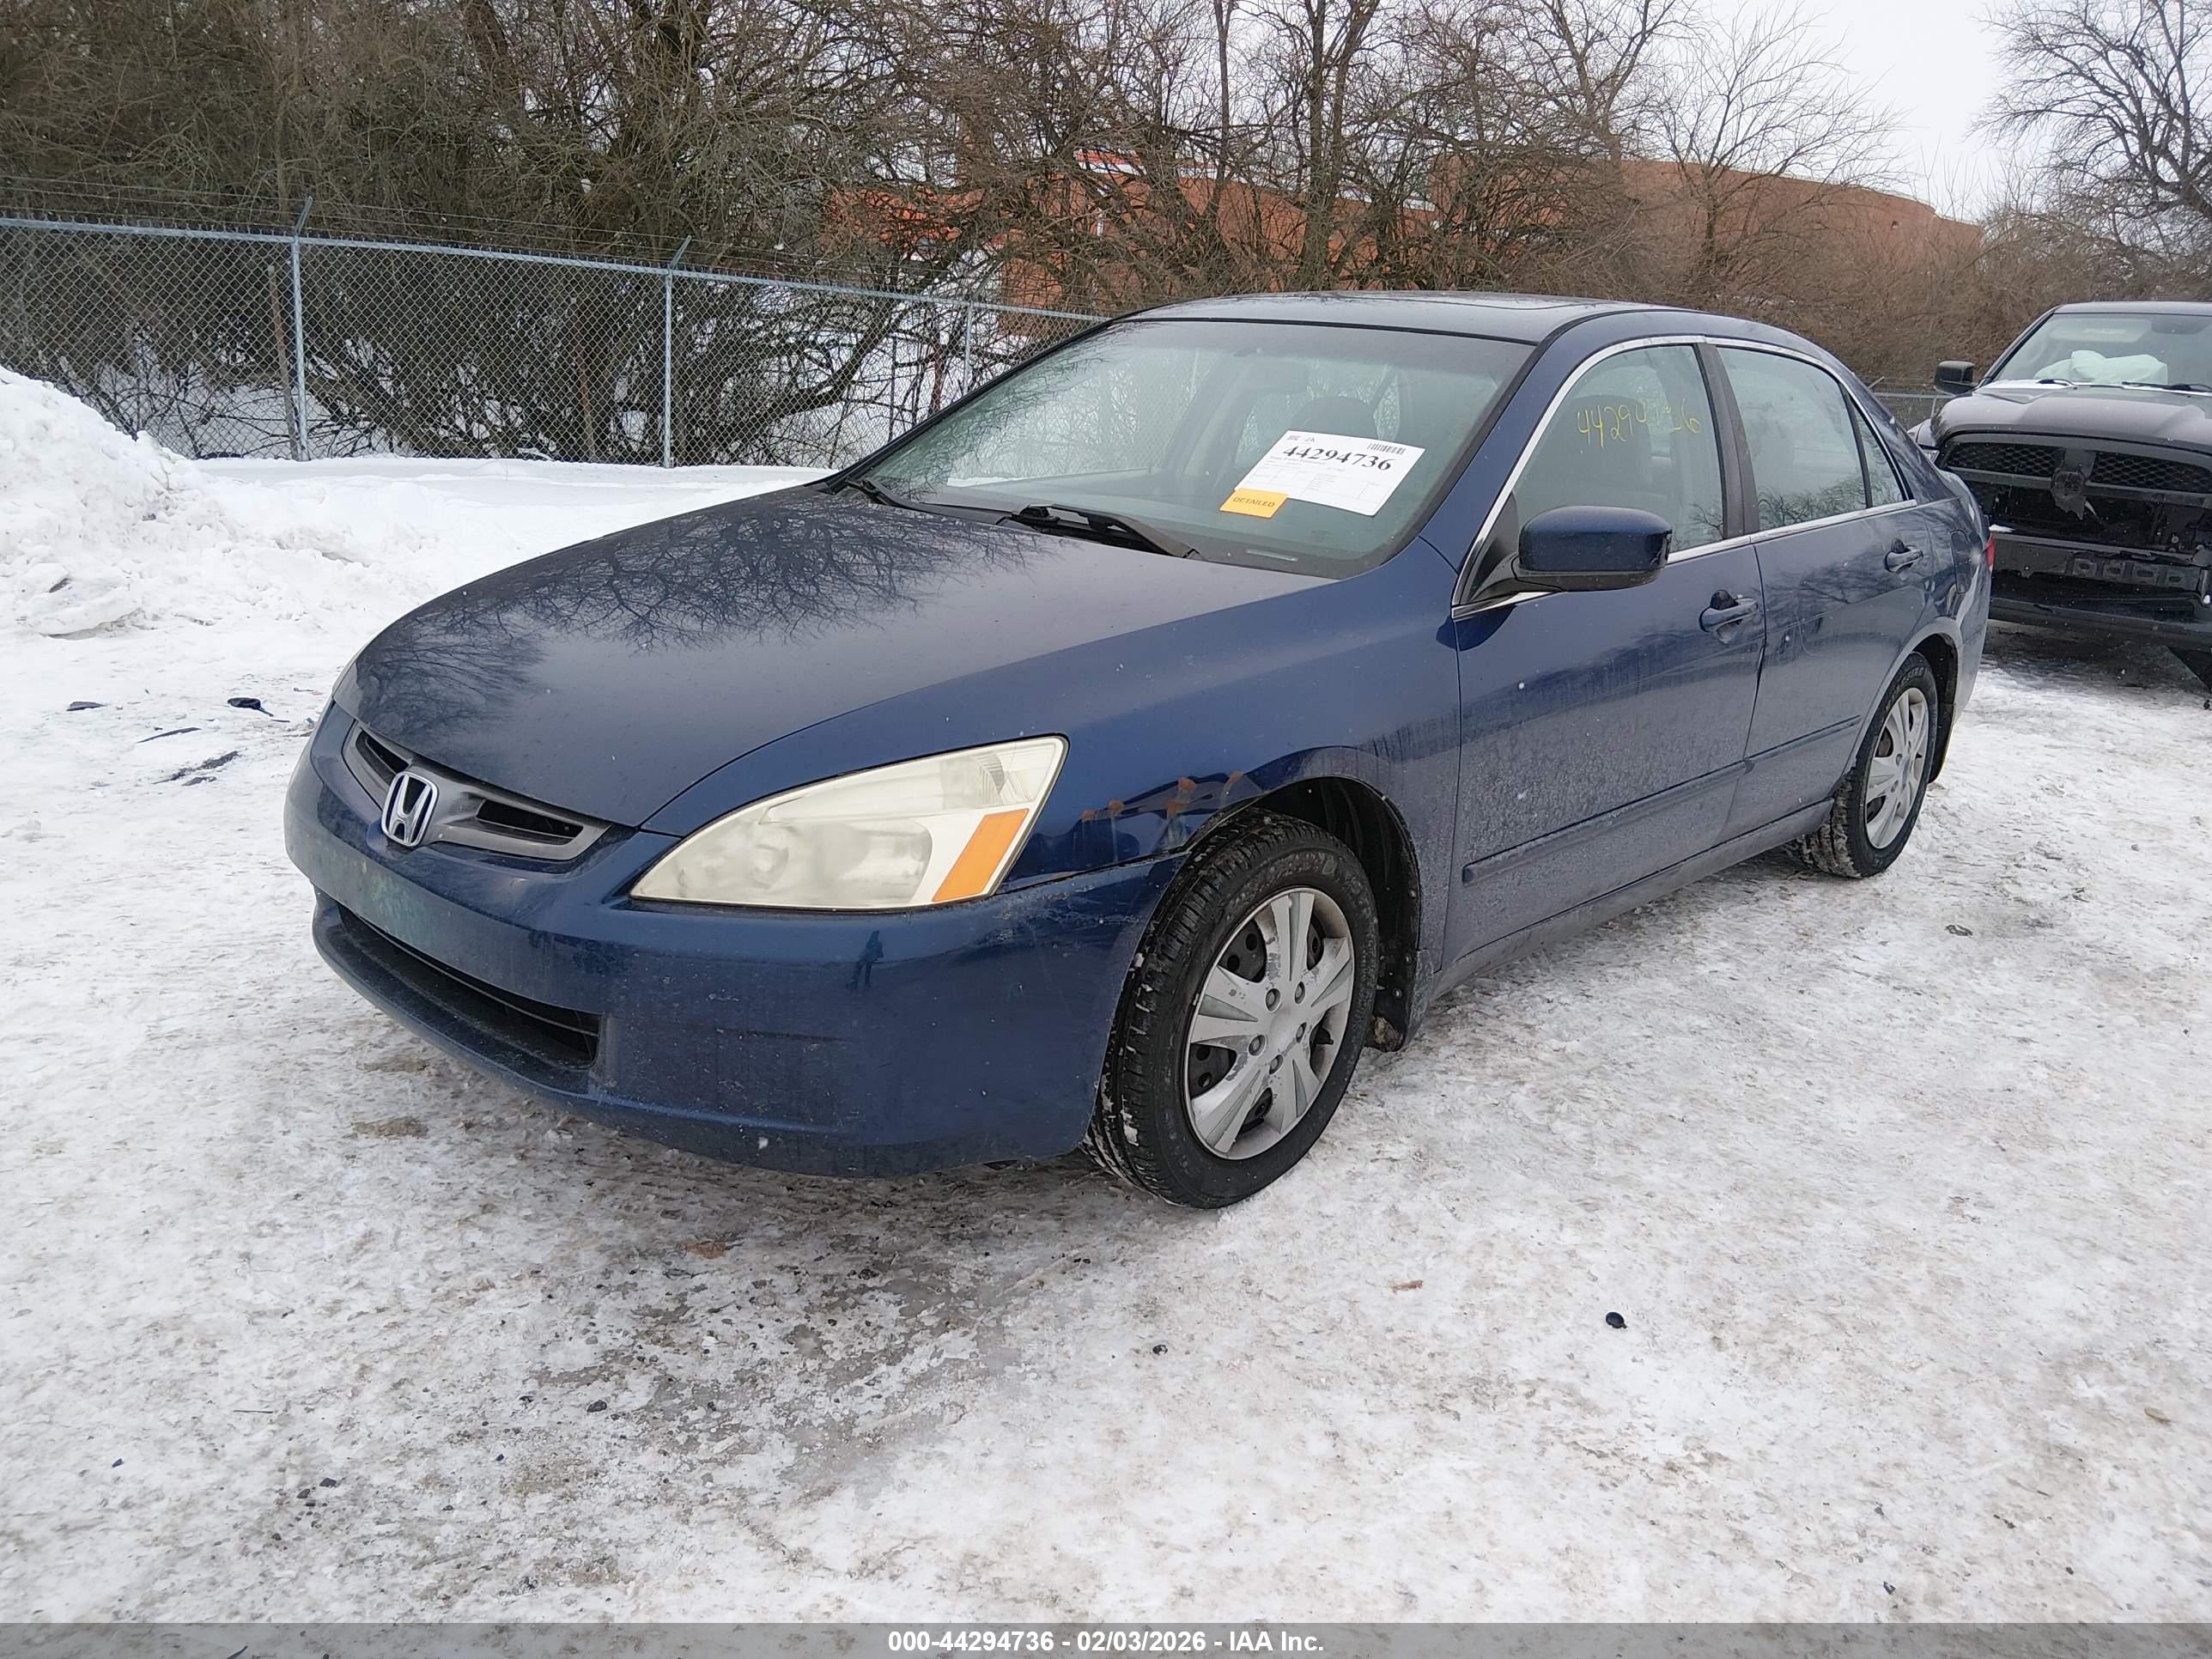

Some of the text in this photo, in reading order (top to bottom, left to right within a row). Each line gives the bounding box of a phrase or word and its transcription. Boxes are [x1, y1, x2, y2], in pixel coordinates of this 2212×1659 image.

[1577, 398, 1703, 448] 442946
[1283, 446, 1395, 471] 44294736
[1232, 496, 1275, 507] DETAILED
